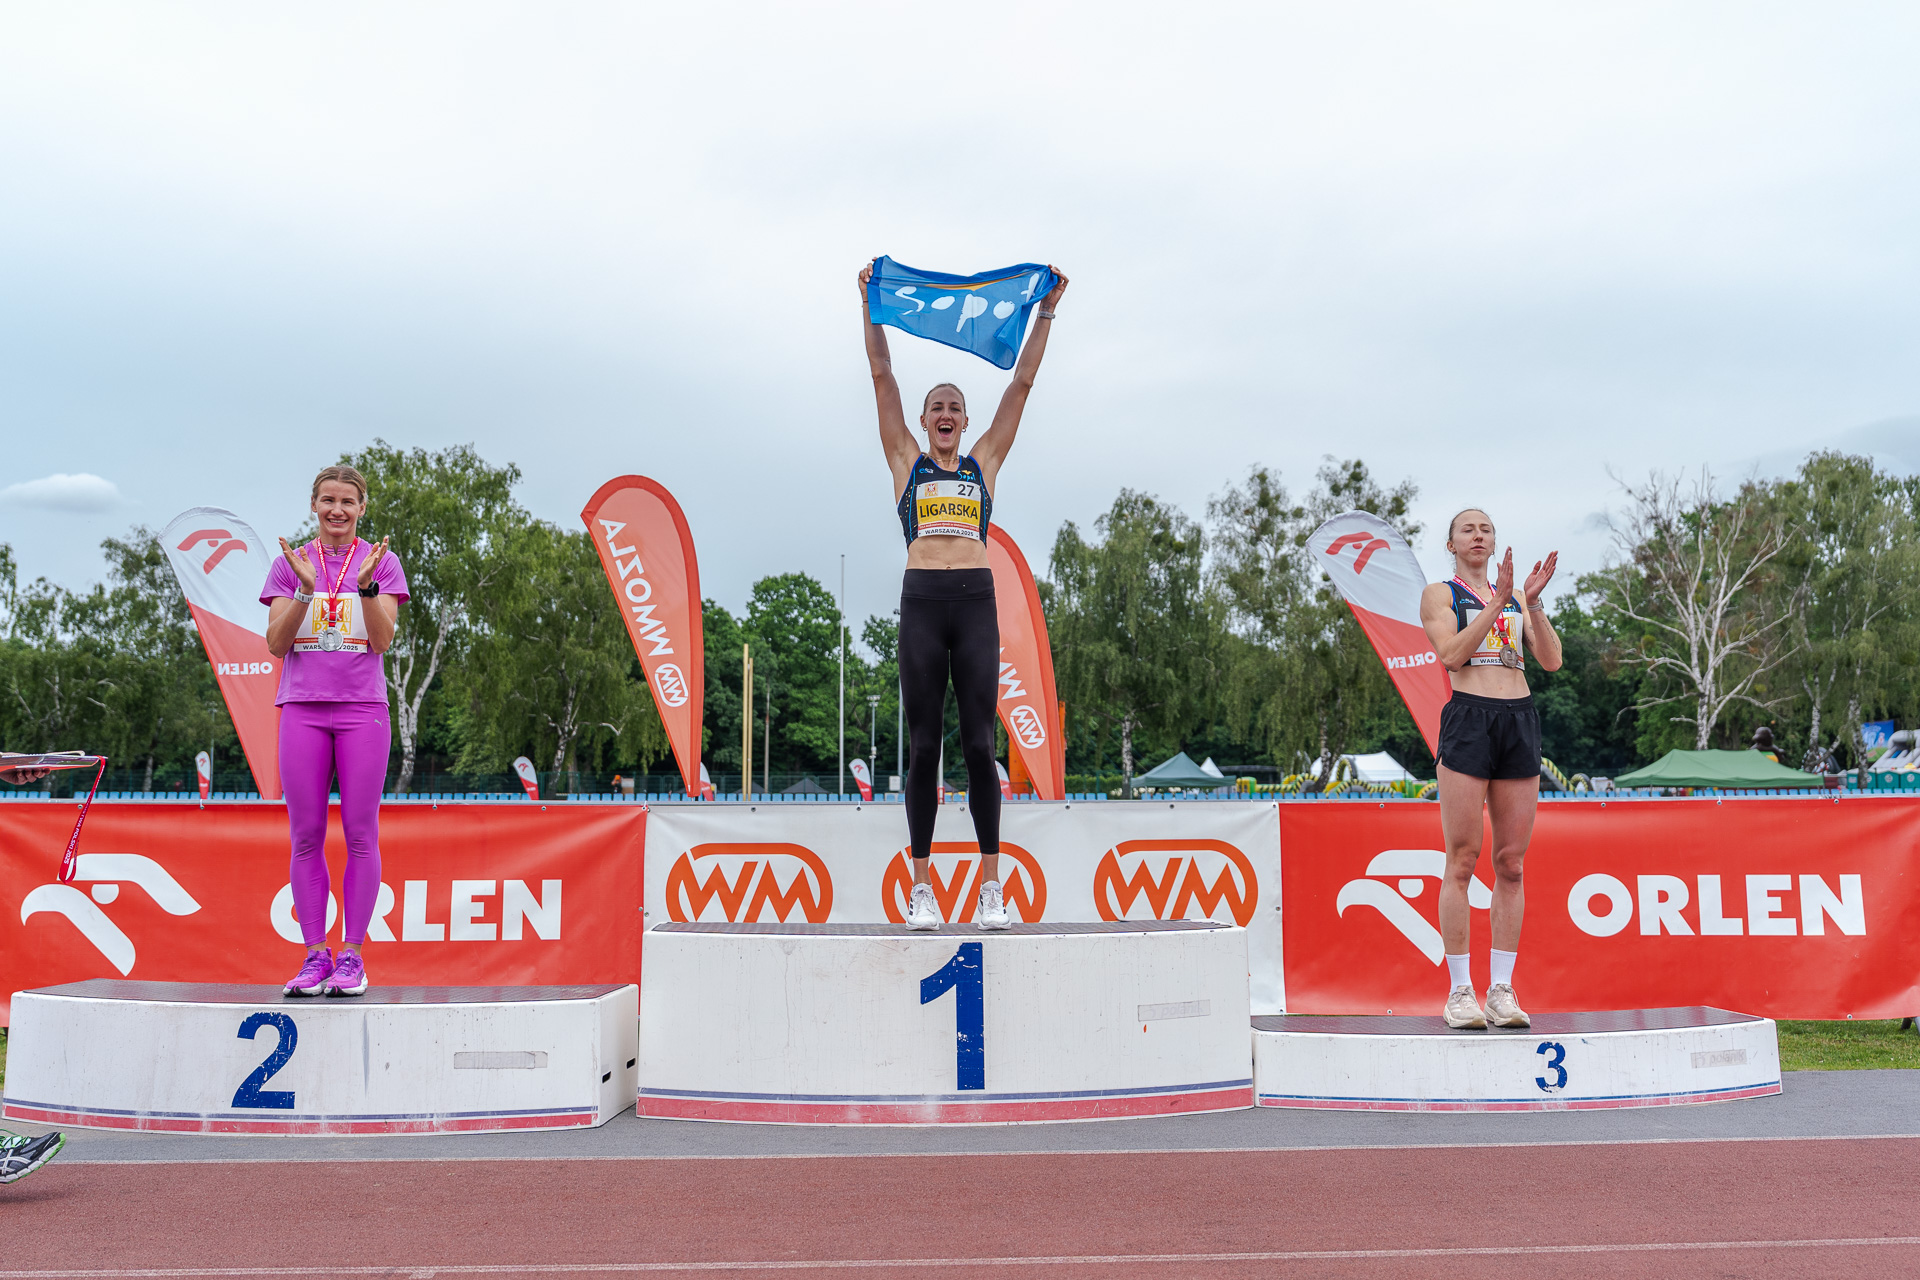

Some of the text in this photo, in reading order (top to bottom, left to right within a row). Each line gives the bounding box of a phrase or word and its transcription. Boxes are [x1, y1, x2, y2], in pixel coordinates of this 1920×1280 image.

[957, 484, 974, 496] 27
[920, 503, 978, 520] LIGARSKA
[314, 622, 348, 633] PZA
[1489, 639, 1517, 651] PZA
[1567, 872, 1866, 937] ORLEN
[920, 942, 985, 1090] 1
[231, 1012, 298, 1110] 2
[1534, 1041, 1568, 1094] 3
